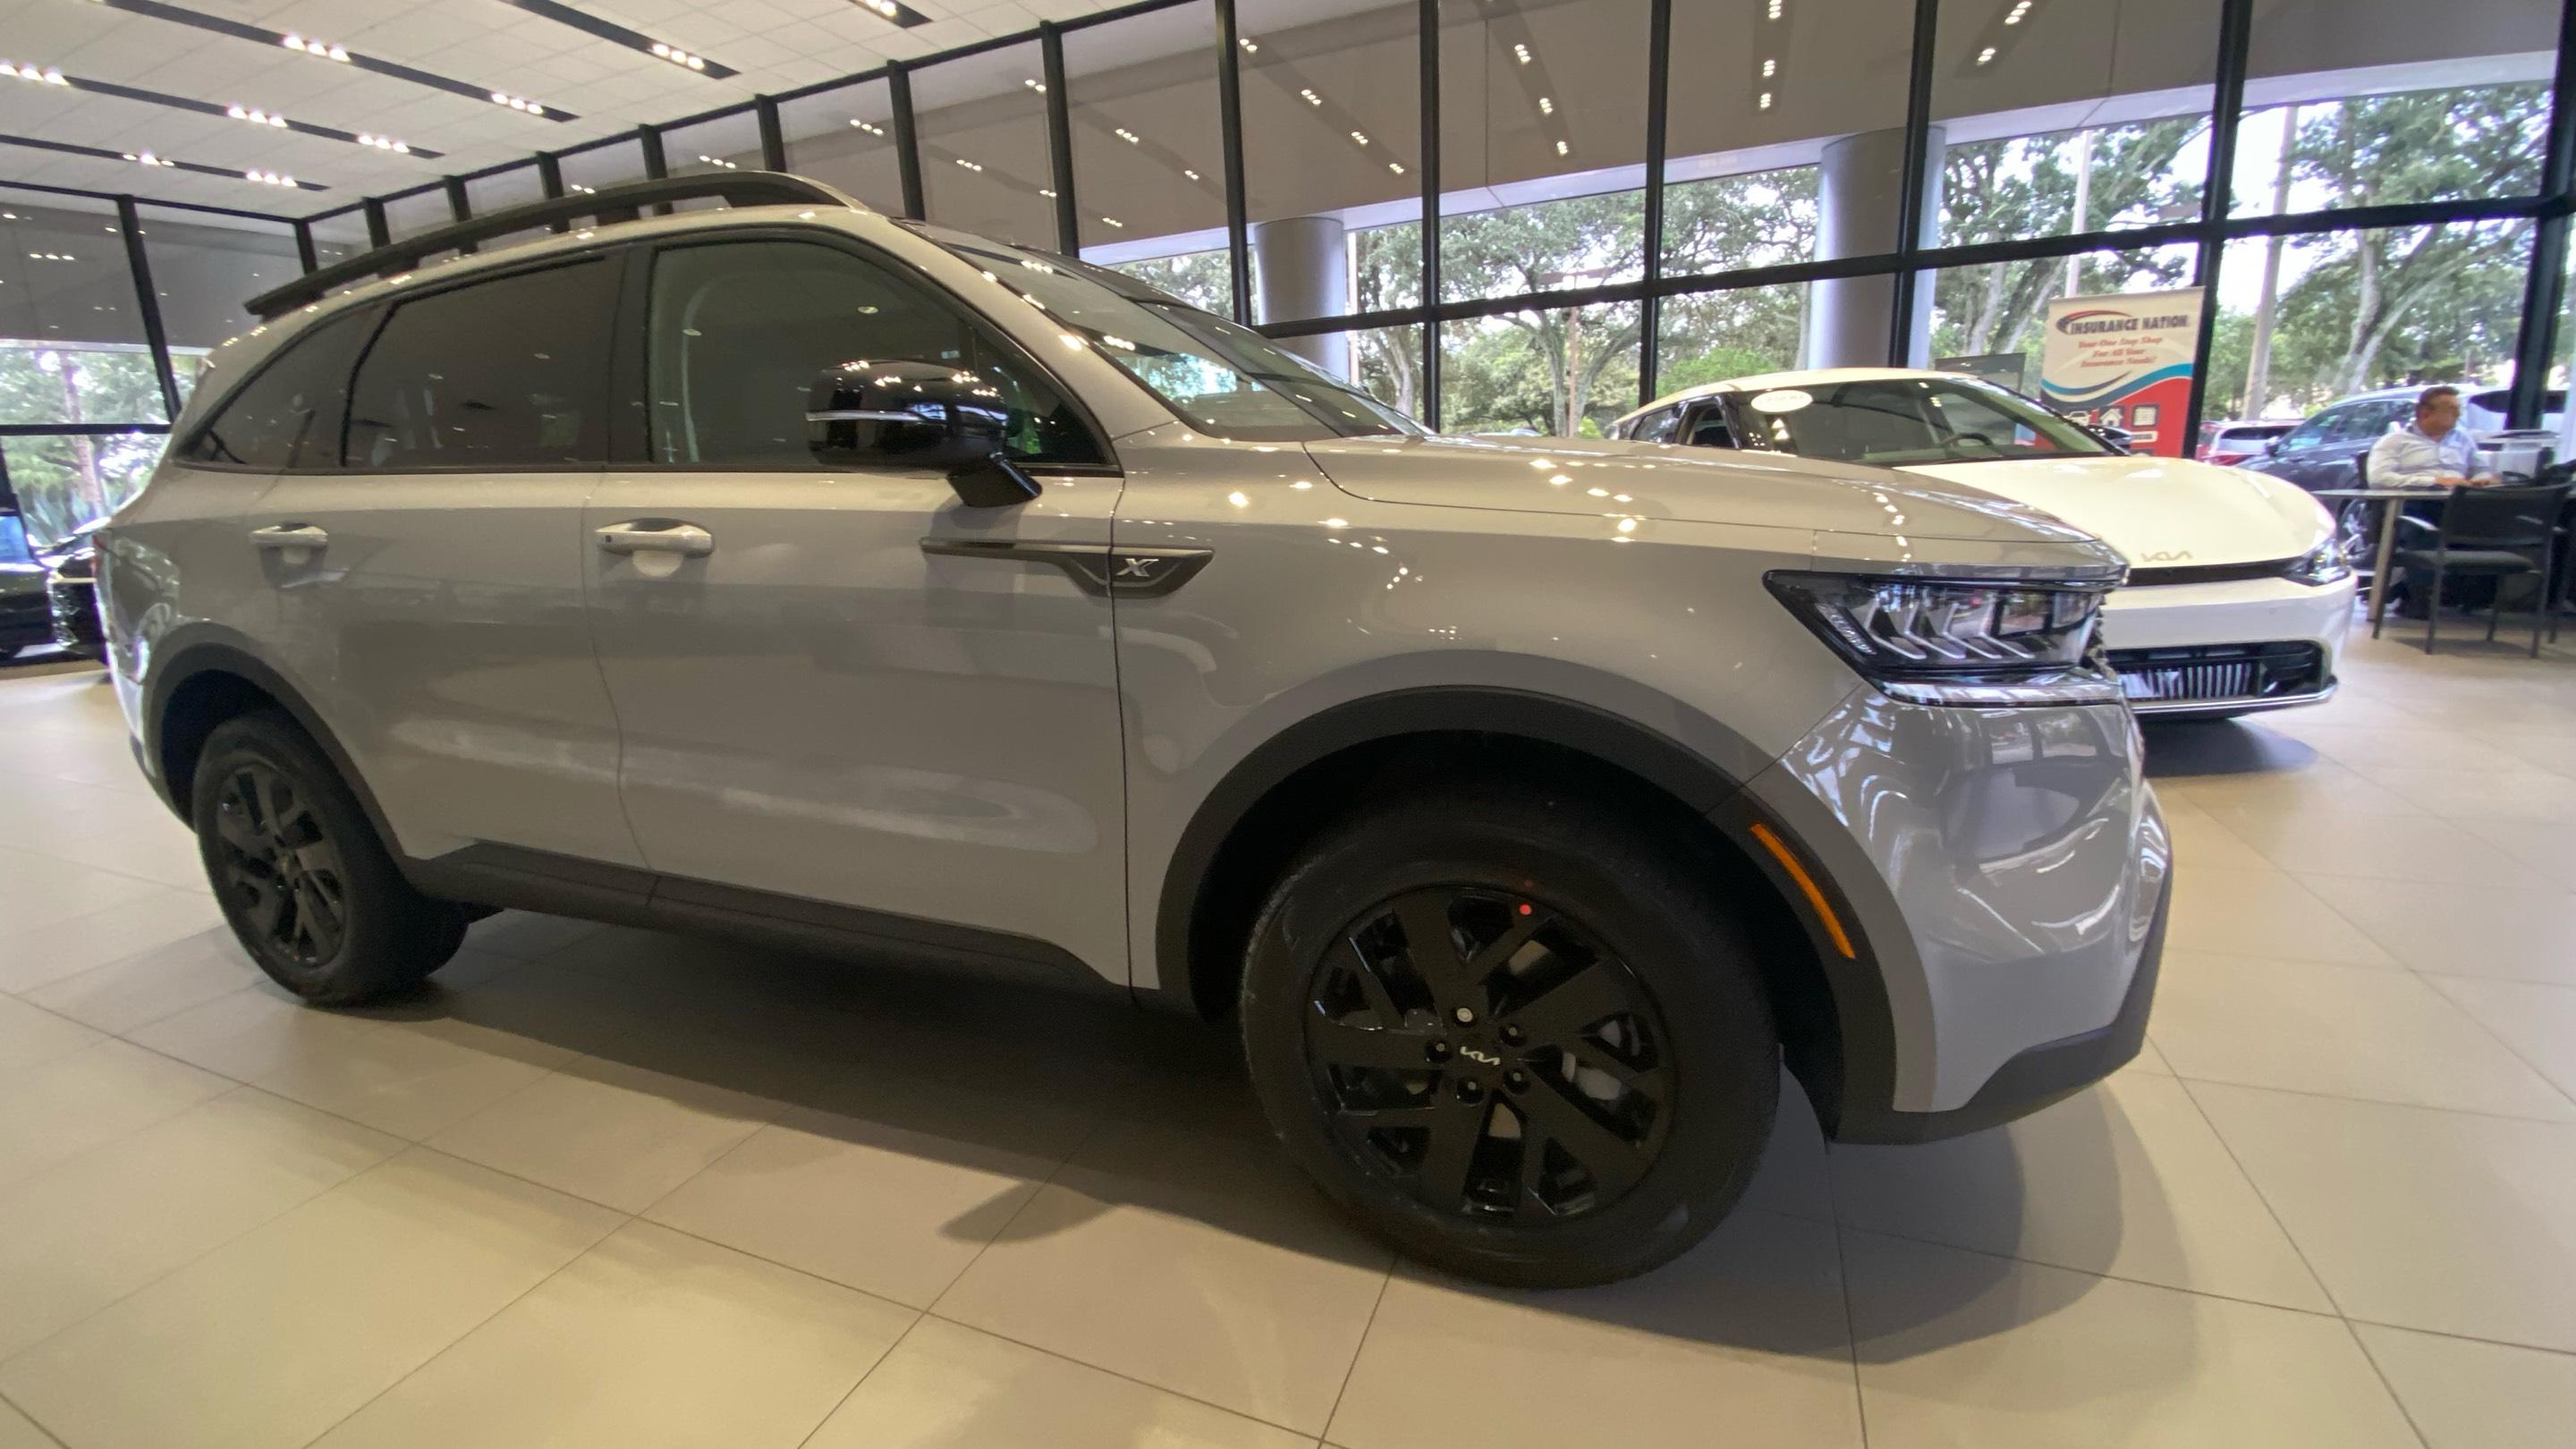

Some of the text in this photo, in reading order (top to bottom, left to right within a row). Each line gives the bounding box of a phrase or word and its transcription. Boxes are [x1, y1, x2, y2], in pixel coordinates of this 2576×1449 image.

[2071, 315, 2189, 334] INSURANCE NATION
[2119, 337, 2139, 347] Stop
[2140, 335, 2162, 344] Shop
[2093, 350, 2108, 358] For
[2081, 360, 2123, 368] Insurance
